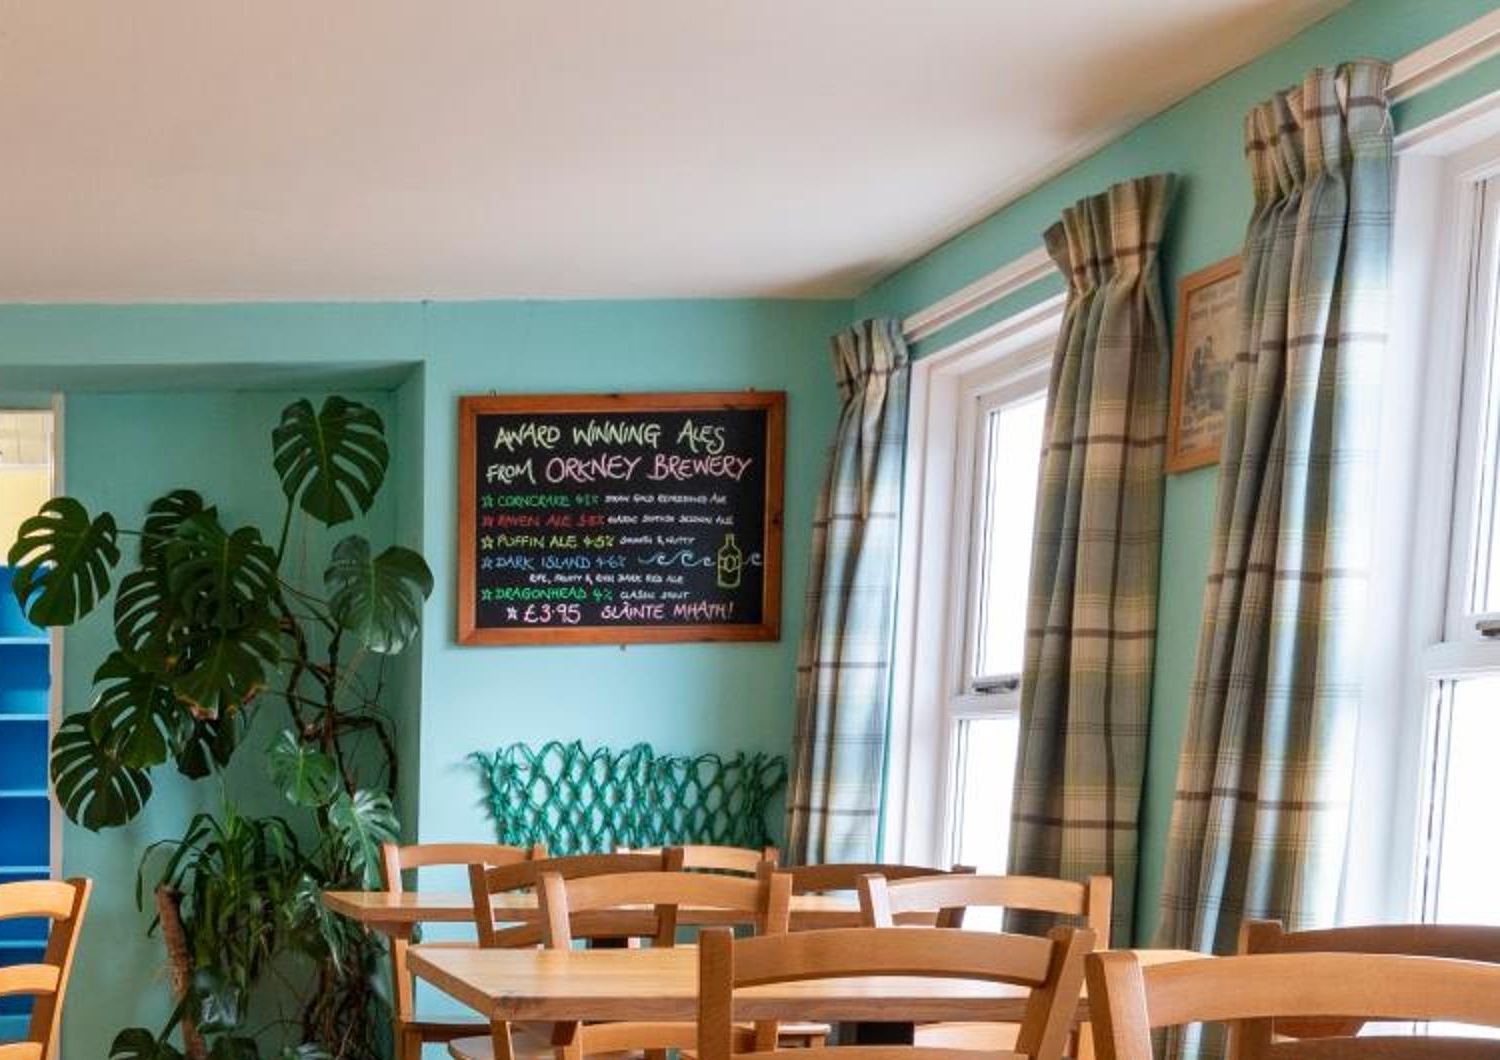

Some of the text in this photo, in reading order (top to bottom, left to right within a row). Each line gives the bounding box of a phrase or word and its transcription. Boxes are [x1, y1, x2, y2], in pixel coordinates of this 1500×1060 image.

[494, 419, 725, 454] AWARD WINNING ALES
[486, 453, 752, 484] FROM ORKNEY BREWERY
[497, 534, 545, 548] PUFFIN
[549, 535, 577, 548] ALE
[496, 554, 535, 570] DARK
[541, 555, 591, 569] ISLAND
[495, 587, 586, 600] DRAGONHEAD
